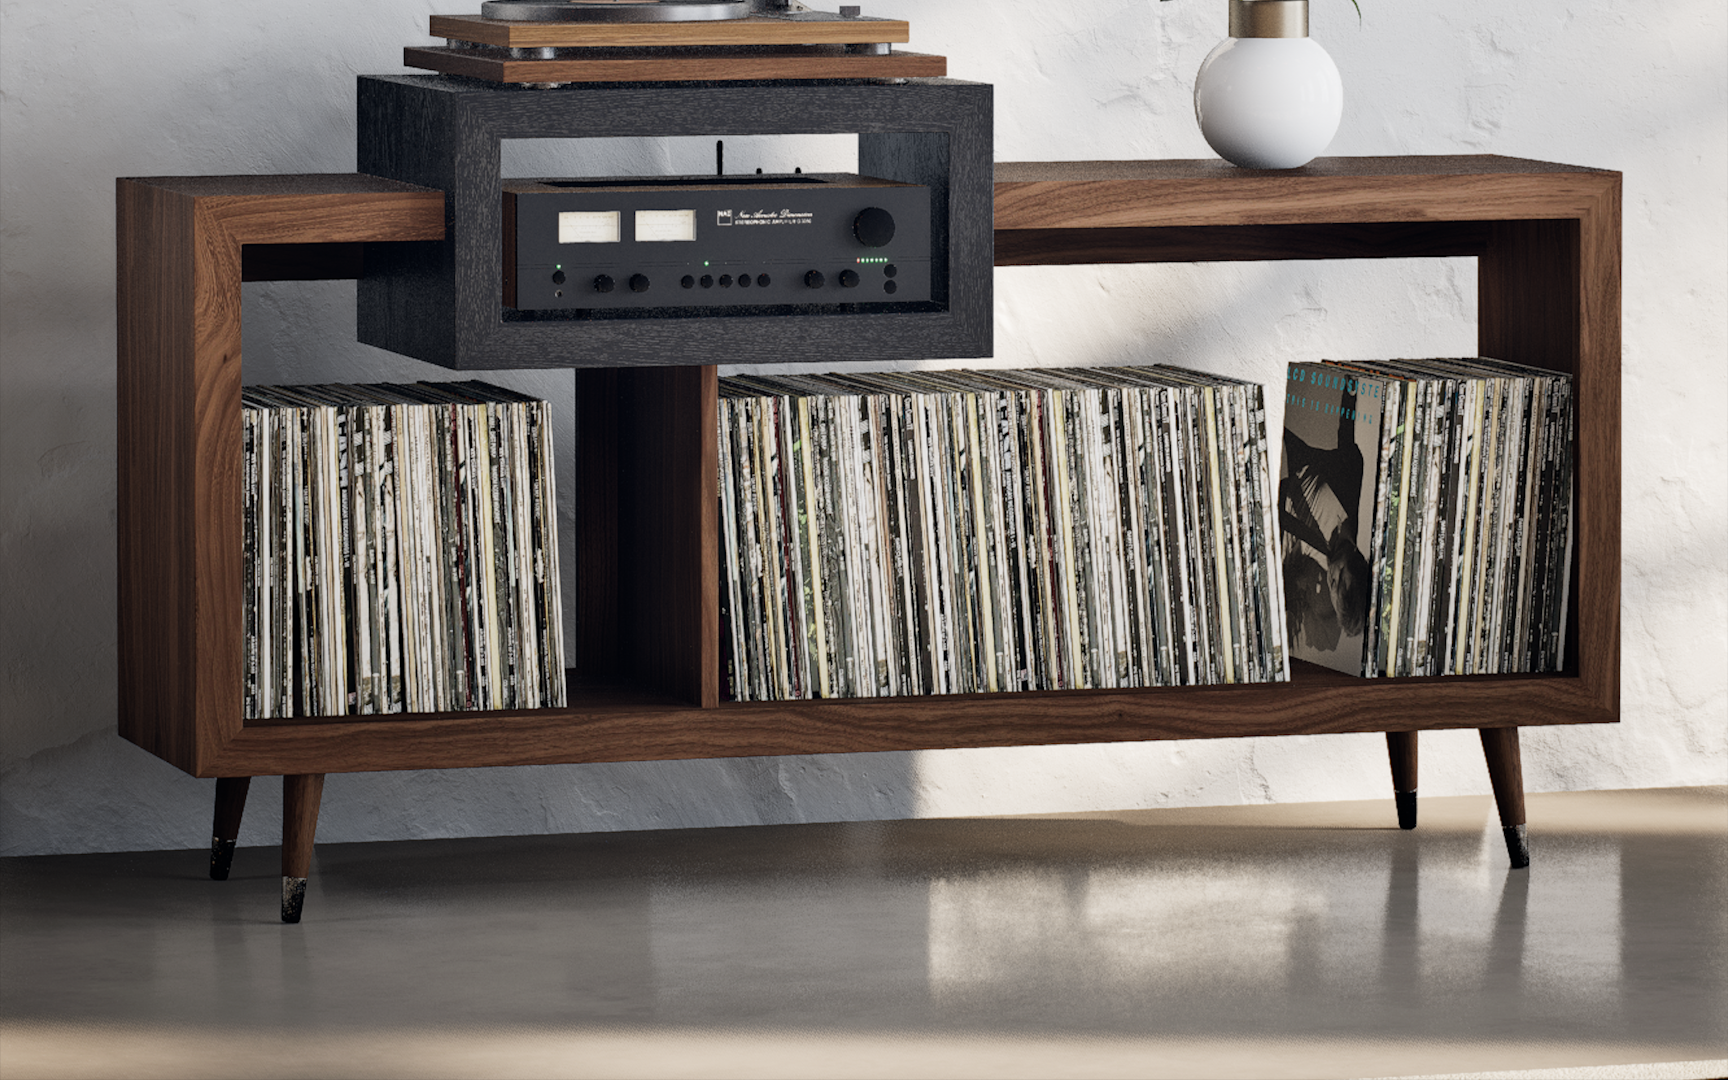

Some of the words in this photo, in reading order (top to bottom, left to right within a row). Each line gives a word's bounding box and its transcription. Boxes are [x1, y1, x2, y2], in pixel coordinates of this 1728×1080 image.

[1287, 366, 1306, 382] LCD
[1286, 393, 1306, 408] THIS
[1310, 400, 1320, 411] IS
[1324, 403, 1373, 425] HAPPENING
